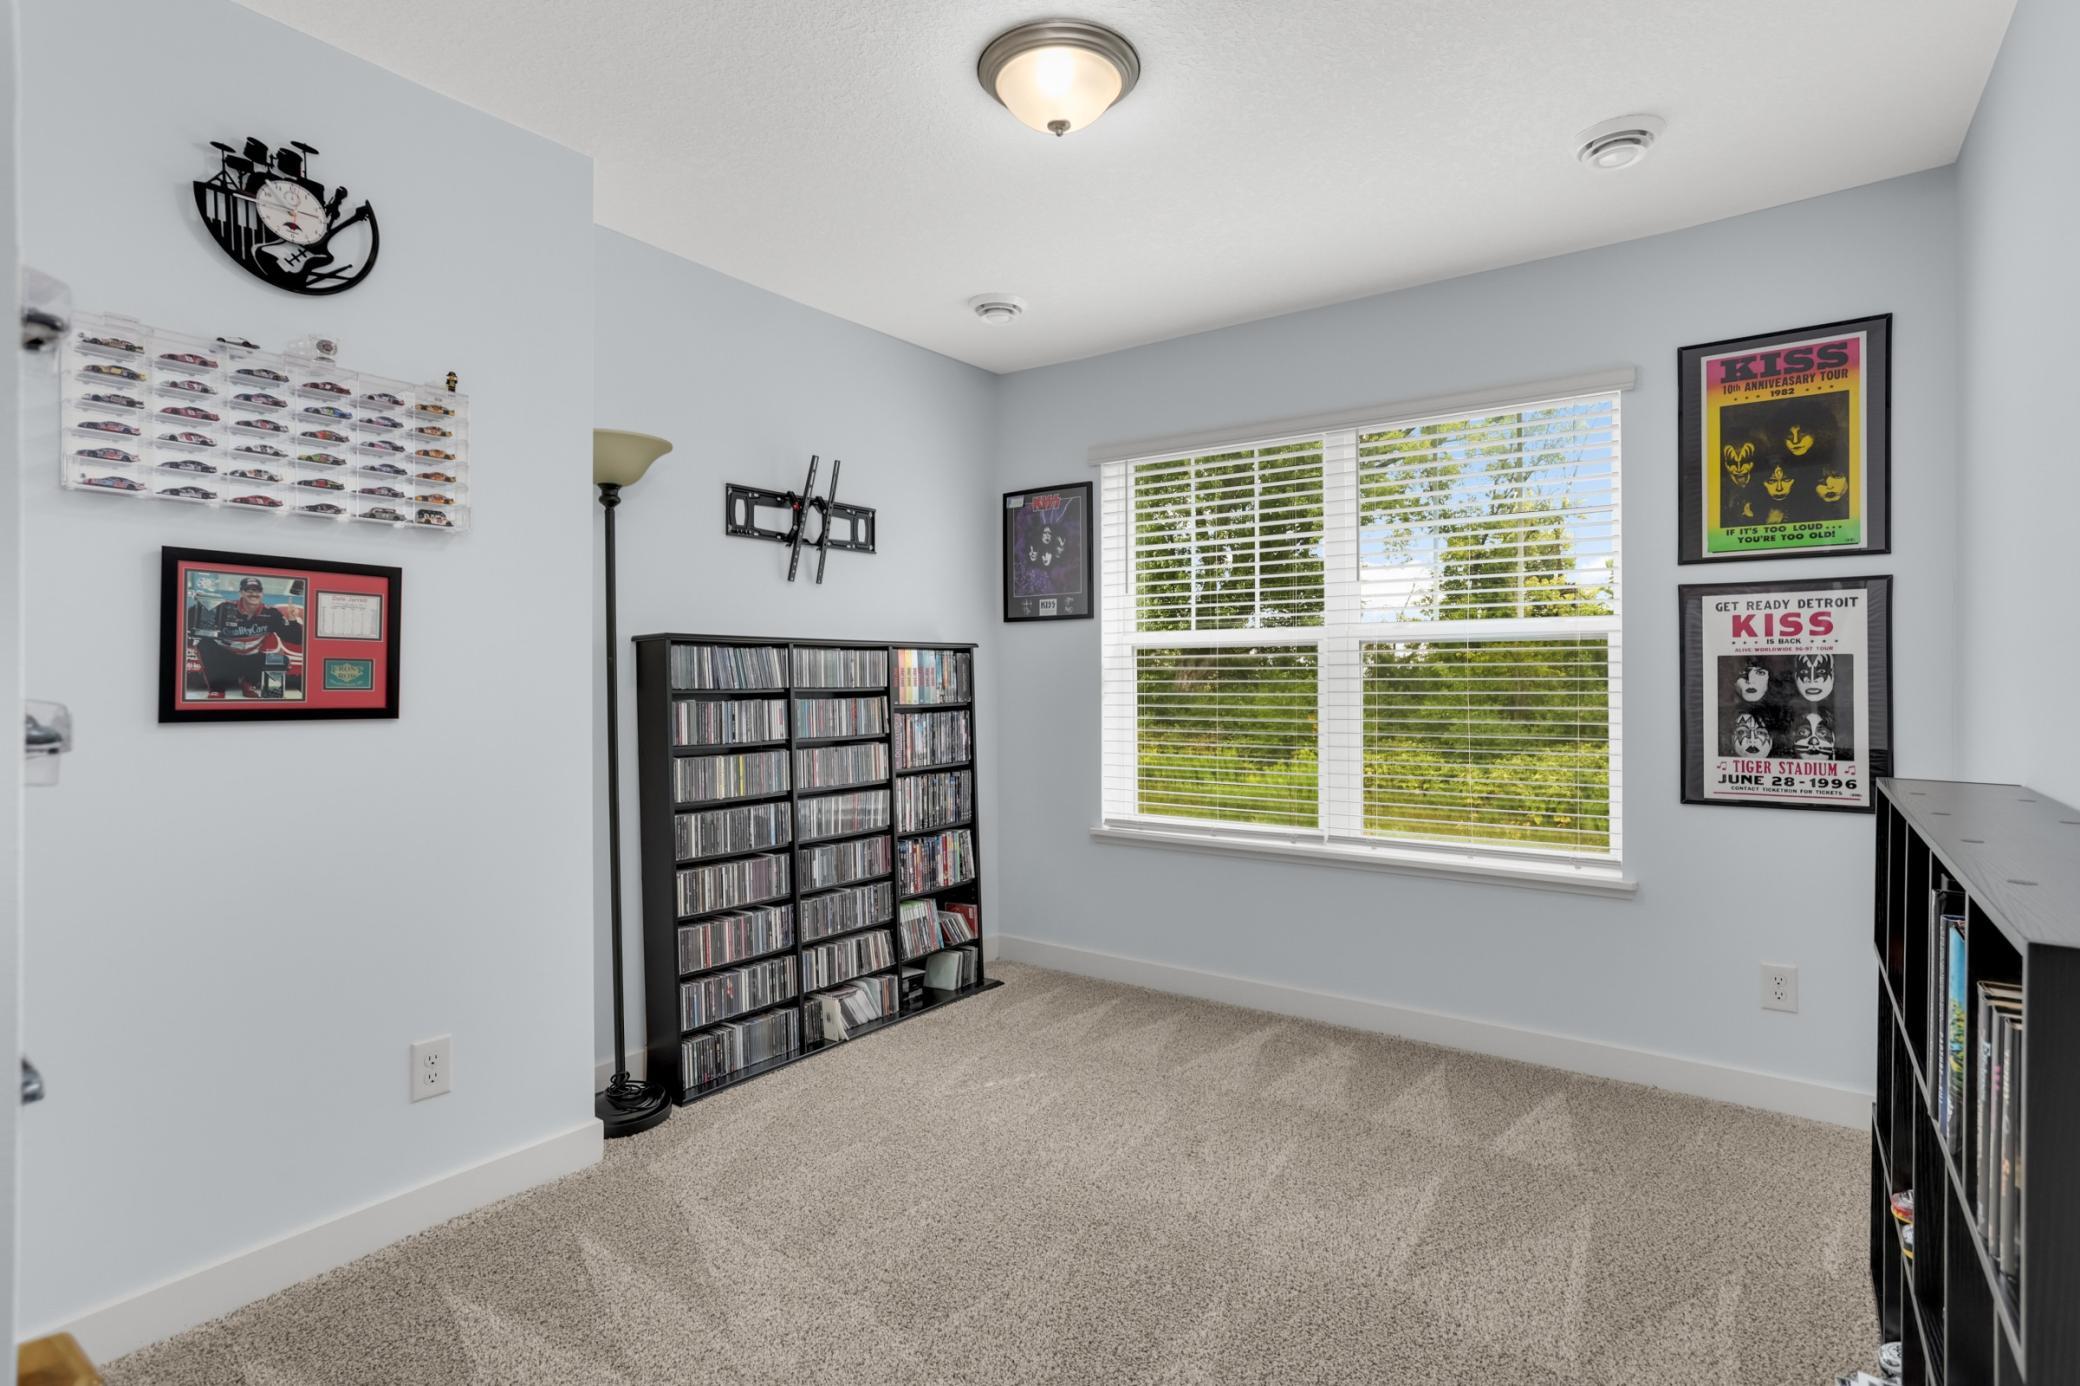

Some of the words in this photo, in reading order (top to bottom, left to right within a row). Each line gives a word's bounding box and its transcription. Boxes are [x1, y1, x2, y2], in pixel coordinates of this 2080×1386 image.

[1720, 342, 1849, 384] KISS
[1723, 385, 1741, 395] 10th
[1820, 368, 1849, 382] TOUR
[1770, 388, 1795, 397] 1982
[1738, 535, 1776, 543] YOU'RE
[1781, 533, 1804, 541] TOO
[1809, 530, 1836, 539] OLD!
[1740, 527, 1758, 535] IT'S
[1764, 525, 1787, 533] TOO
[1715, 601, 1739, 612] GET
[1746, 600, 1791, 611] READY
[1797, 596, 1859, 609] DETROIT
[1732, 611, 1834, 638] KISS
[1733, 760, 1772, 774] TIGER
[1778, 761, 1838, 777] STADIUM
[1718, 774, 1765, 786] JUNE
